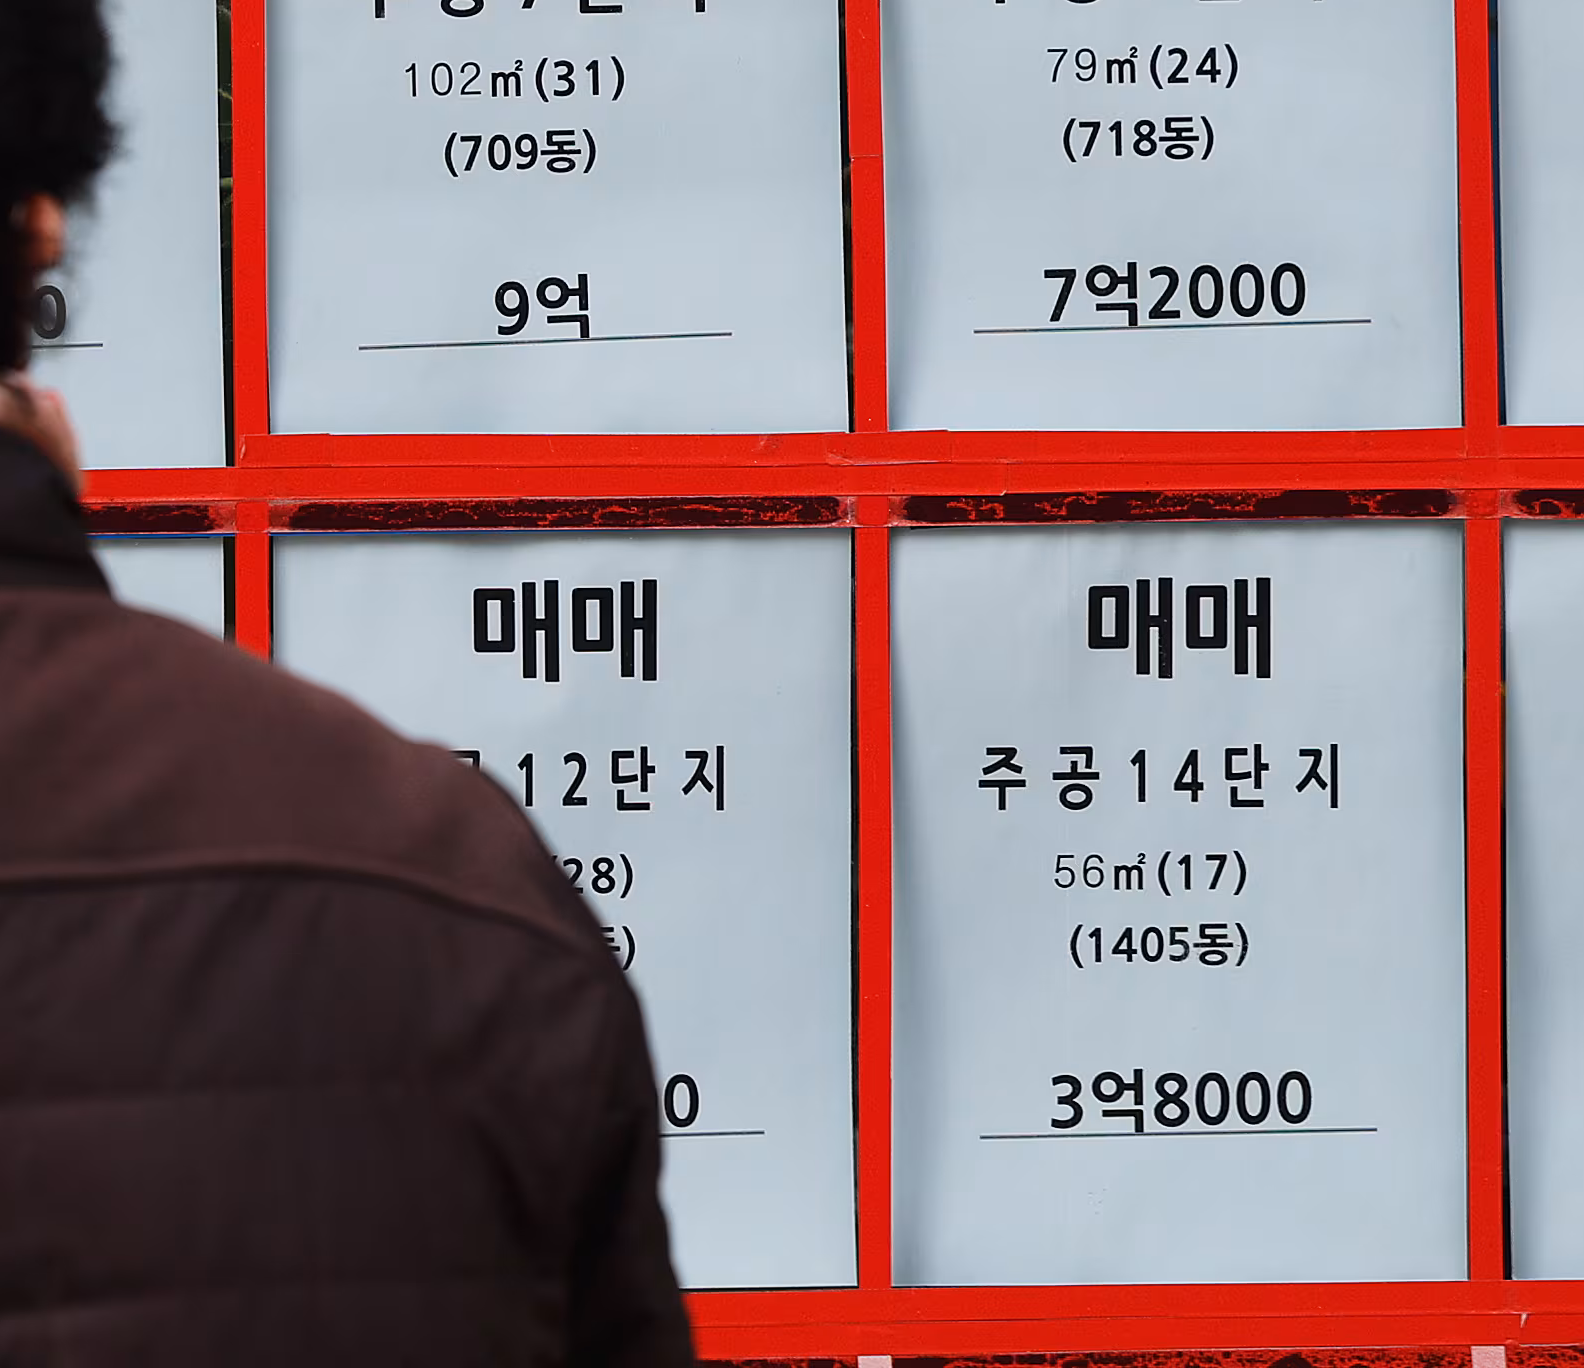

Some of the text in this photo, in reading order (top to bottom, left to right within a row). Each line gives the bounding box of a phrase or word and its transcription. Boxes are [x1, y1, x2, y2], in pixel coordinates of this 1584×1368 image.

[445, 129, 596, 177] (709동)
[1063, 116, 1214, 162] (718동)
[495, 274, 589, 338] 9억
[1044, 262, 1306, 327] 7억2000
[473, 579, 657, 682] 매매
[1088, 577, 1271, 679] 매매
[449, 745, 724, 811] 12단지
[978, 744, 1338, 810] 주공14단지
[1070, 923, 1248, 968] (1405동)
[1050, 1069, 1312, 1133] 3억8000
